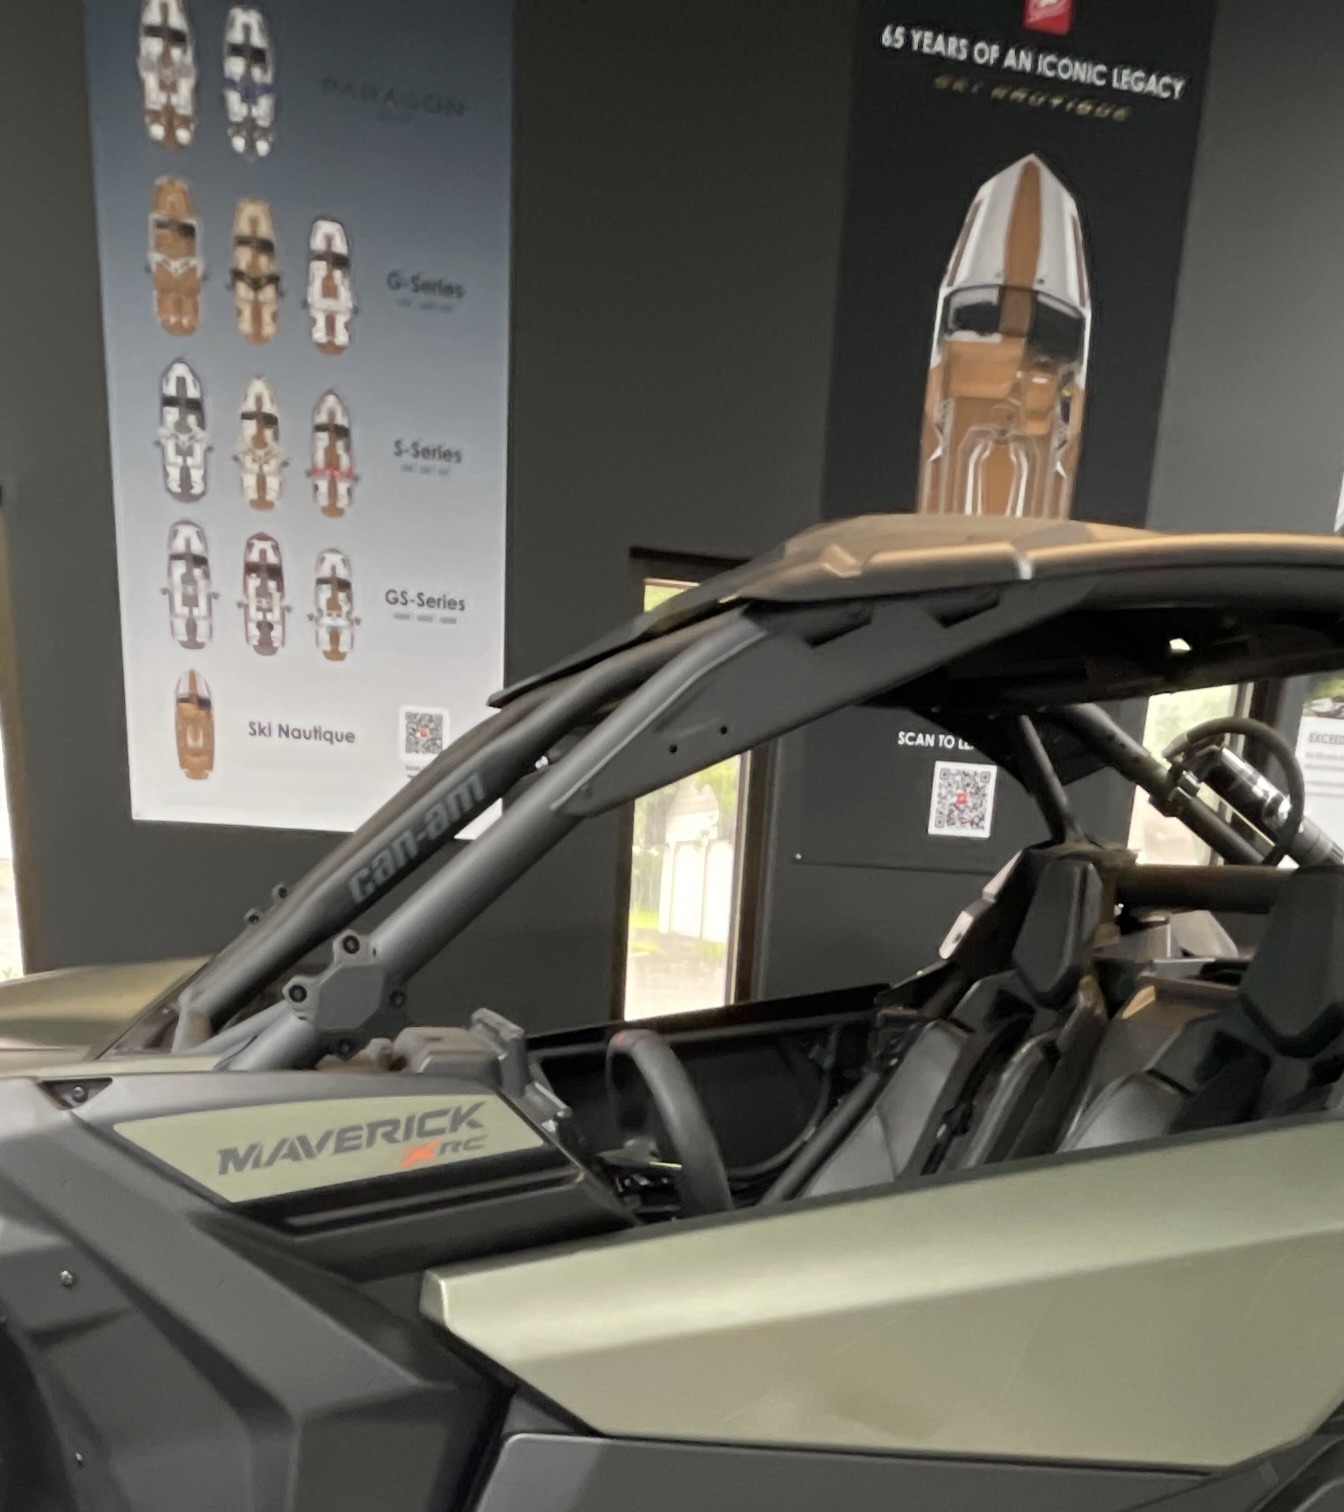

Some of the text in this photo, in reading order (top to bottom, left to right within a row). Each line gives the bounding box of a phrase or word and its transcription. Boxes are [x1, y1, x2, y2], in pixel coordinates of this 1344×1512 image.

[880, 23, 1187, 99] 65 YEARS OF AN ICONIC LEGACY
[393, 438, 463, 464] S-Series
[384, 587, 466, 611] GS-Series
[248, 720, 356, 746] Ski Nautique
[897, 730, 935, 748] SCAN
[938, 734, 956, 749] TO
[348, 771, 486, 903] can-am
[217, 1101, 488, 1176] MAVERICK
